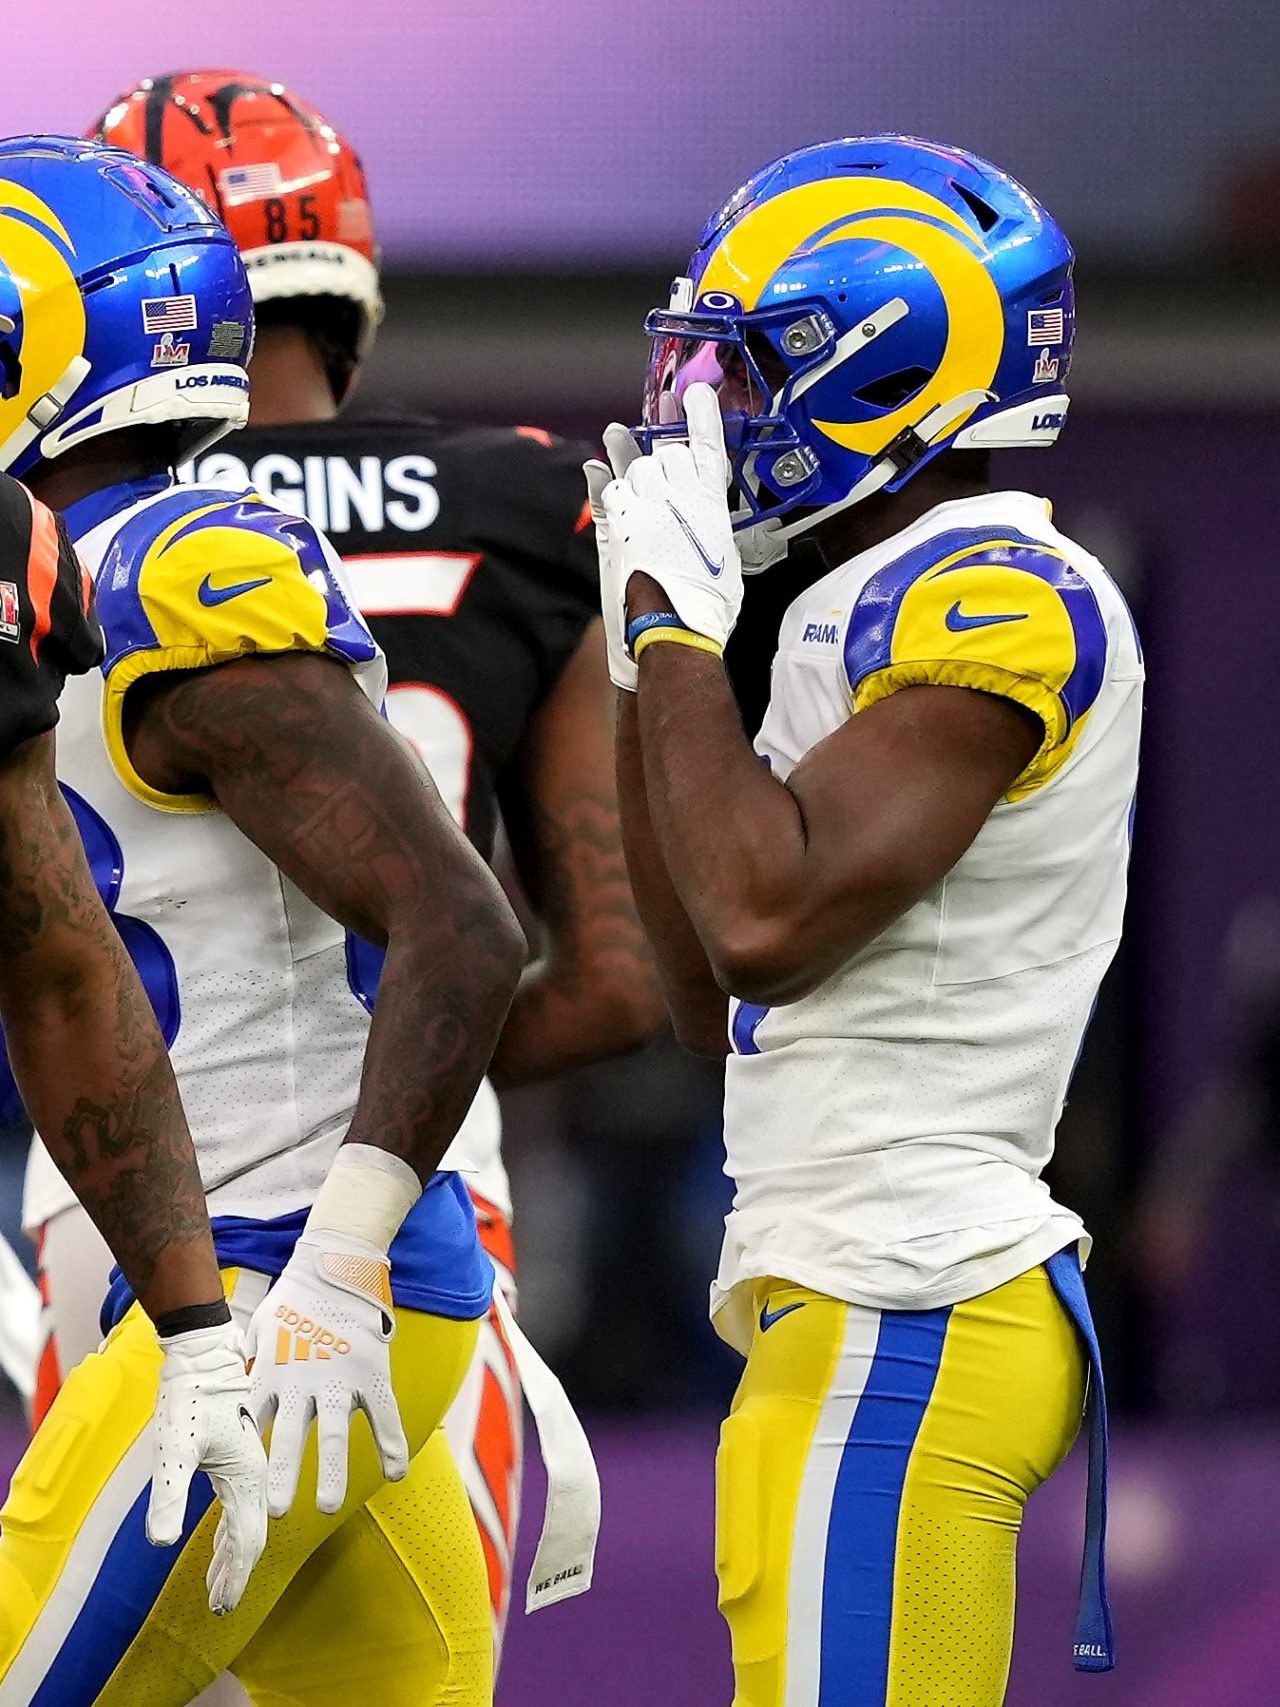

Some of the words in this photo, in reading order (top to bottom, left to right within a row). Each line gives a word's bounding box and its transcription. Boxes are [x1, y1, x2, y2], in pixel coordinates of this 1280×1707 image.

[265, 195, 320, 244] 85
[176, 376, 208, 390] LOS
[275, 1305, 352, 1355] adidas
